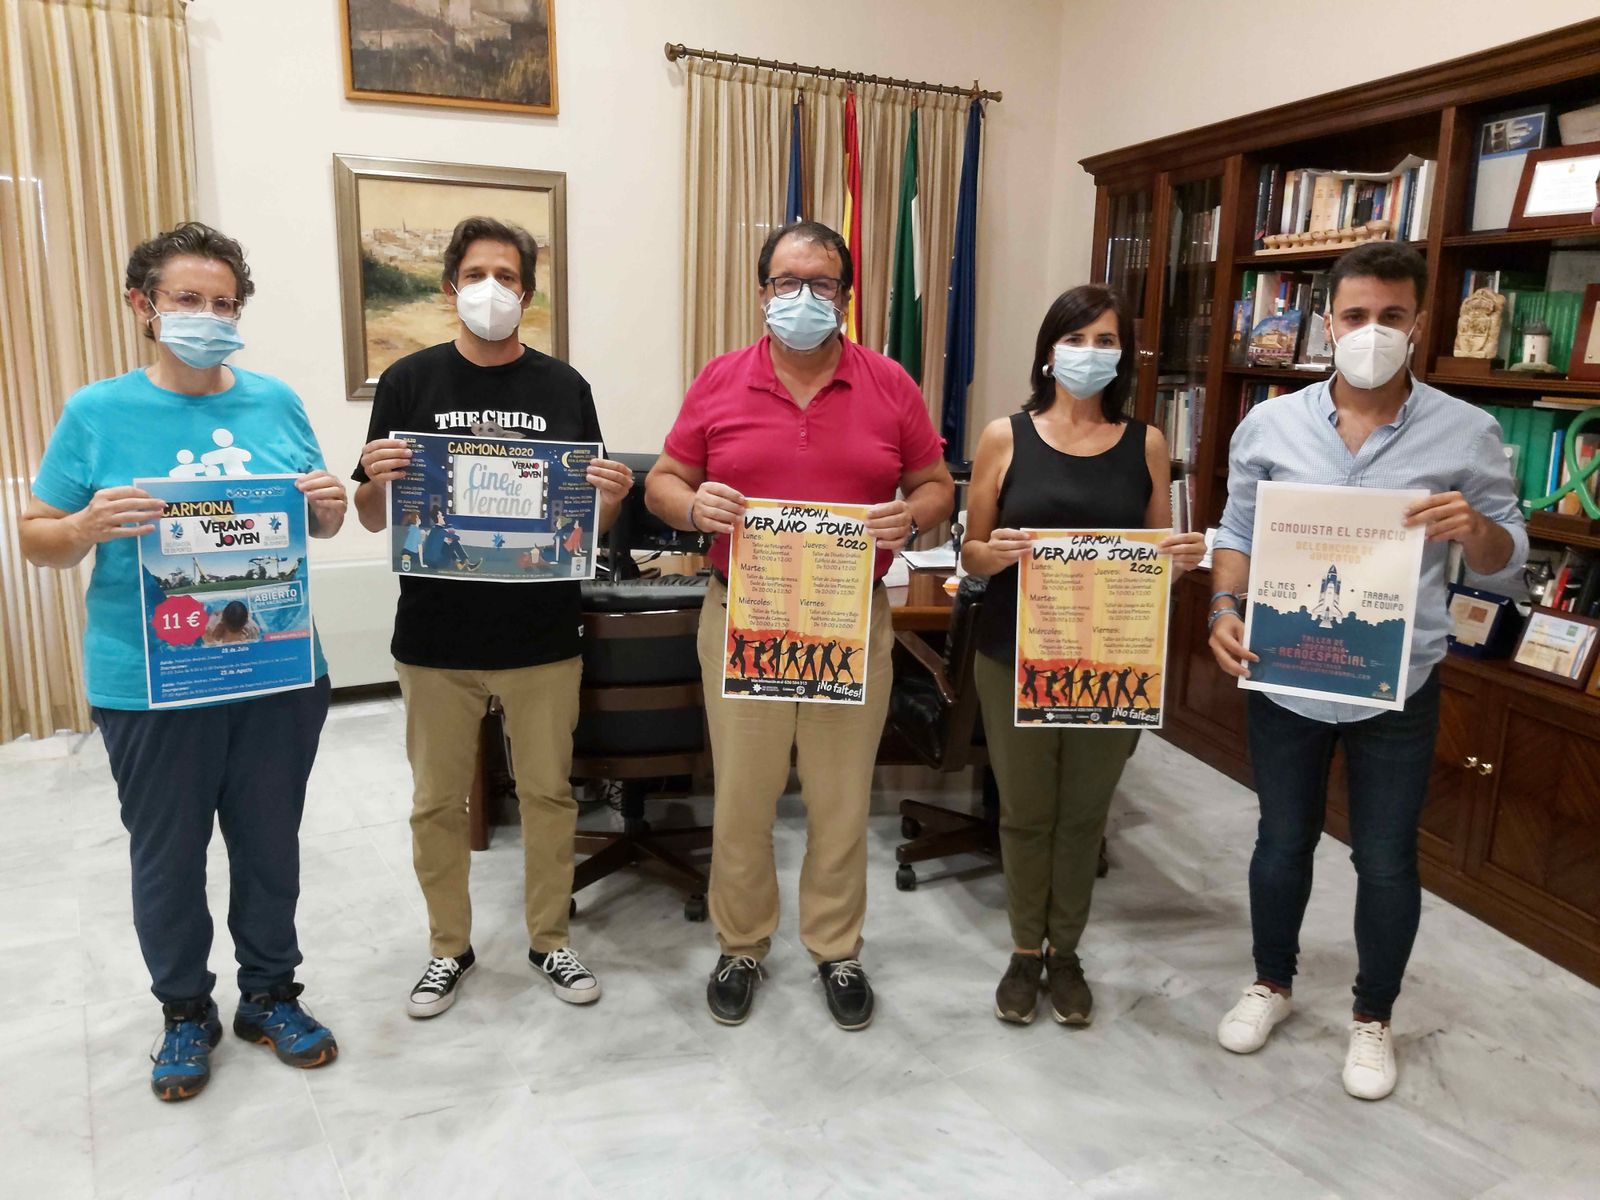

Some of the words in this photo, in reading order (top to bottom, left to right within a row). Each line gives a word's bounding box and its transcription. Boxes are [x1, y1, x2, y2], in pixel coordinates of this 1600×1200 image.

[434, 411, 480, 430] THE
[482, 410, 547, 432] CHILD
[448, 441, 508, 456] CARMONA
[509, 447, 534, 457] 2020
[512, 460, 540, 470] VERANO
[469, 463, 510, 491] Cine
[505, 480, 523, 497] de
[519, 469, 542, 478] JOVEN
[463, 487, 532, 516] Verano
[161, 500, 234, 518] CARMONA
[781, 506, 829, 520] CARMONA
[200, 518, 255, 534] VERANO
[744, 516, 807, 536] VERANO
[815, 522, 864, 536] JOVEN
[1270, 522, 1333, 536] CONQUISTA
[1337, 526, 1351, 537] EL
[1356, 527, 1407, 542] ESPACIO
[216, 532, 260, 548] JOVEN
[742, 531, 764, 540] Lunes:
[1072, 535, 1121, 547] CARMONA
[802, 539, 829, 549] Jueves:
[836, 537, 868, 551] 2020
[1033, 546, 1098, 565] VERANO
[1107, 547, 1158, 561] JOVEN
[740, 562, 768, 572] Martes:
[1129, 562, 1163, 575] 2020
[1264, 580, 1274, 589] EL
[1278, 581, 1296, 591] MES
[254, 588, 297, 602] ABIERTO
[1258, 588, 1268, 597] DE
[1272, 589, 1297, 600] JULIO
[1363, 590, 1400, 601] TRABAJA
[738, 597, 773, 606] Miércoles:
[1361, 599, 1373, 608] EN
[1374, 600, 1404, 613] EQUIPO
[162, 613, 181, 630] 11
[186, 611, 200, 627] €
[1278, 646, 1367, 667] AEROESPACIAL
[817, 680, 832, 692] ¡No
[833, 683, 862, 698] faltes!
[1112, 707, 1128, 718] ¡No
[1129, 709, 1159, 722] faltes!
